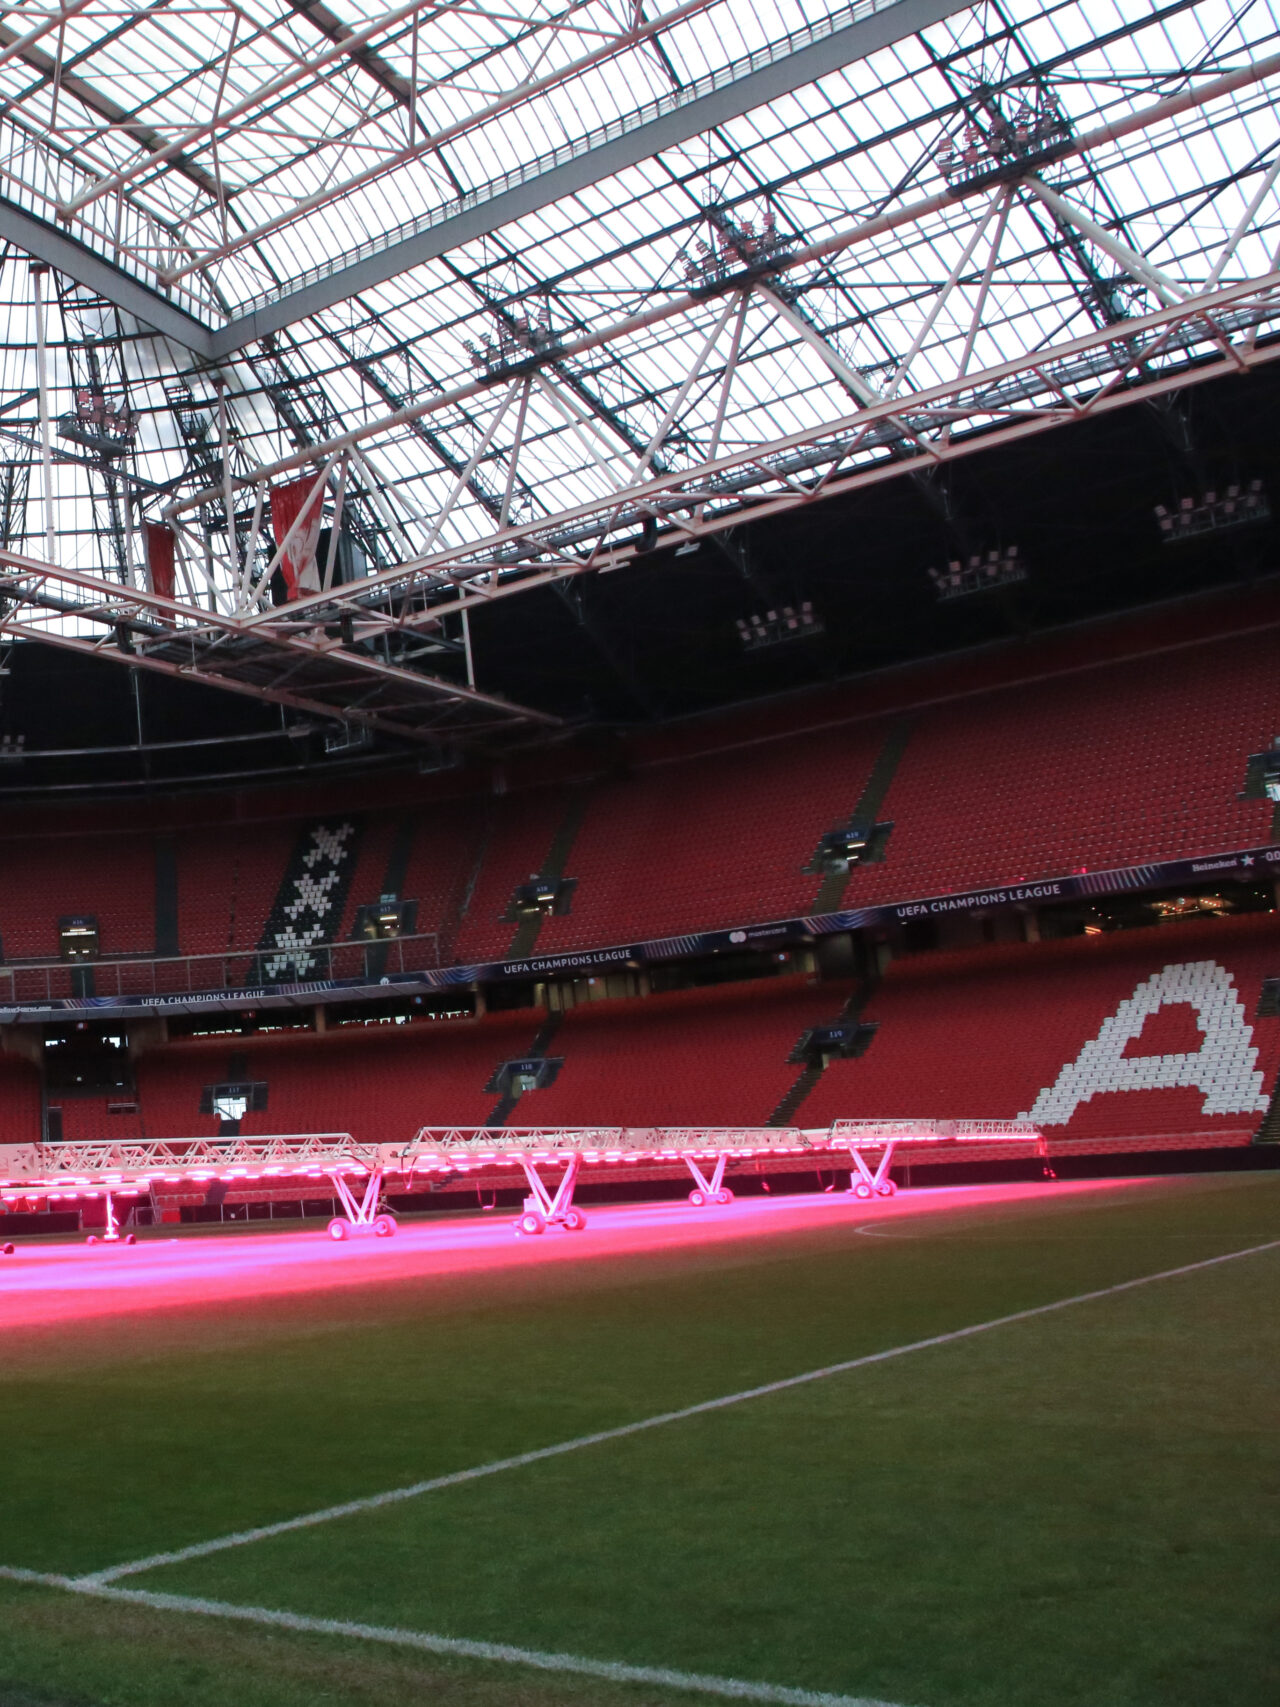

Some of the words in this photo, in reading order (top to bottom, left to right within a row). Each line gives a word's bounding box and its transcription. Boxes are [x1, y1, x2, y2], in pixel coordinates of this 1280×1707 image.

[1192, 858, 1238, 872] Heineken
[897, 905, 928, 917] UEFA
[930, 892, 1007, 912] CHAMPIONS
[1009, 884, 1061, 901] LEAGUE
[503, 963, 530, 974] UEFA
[531, 955, 592, 970] CHAMPIONS
[593, 949, 632, 962] LEAGUE
[141, 998, 166, 1006] UEFA
[168, 993, 226, 1004] CHAMPIONS
[227, 990, 265, 1000] LEAGUE
[1017, 960, 1270, 1127] A
